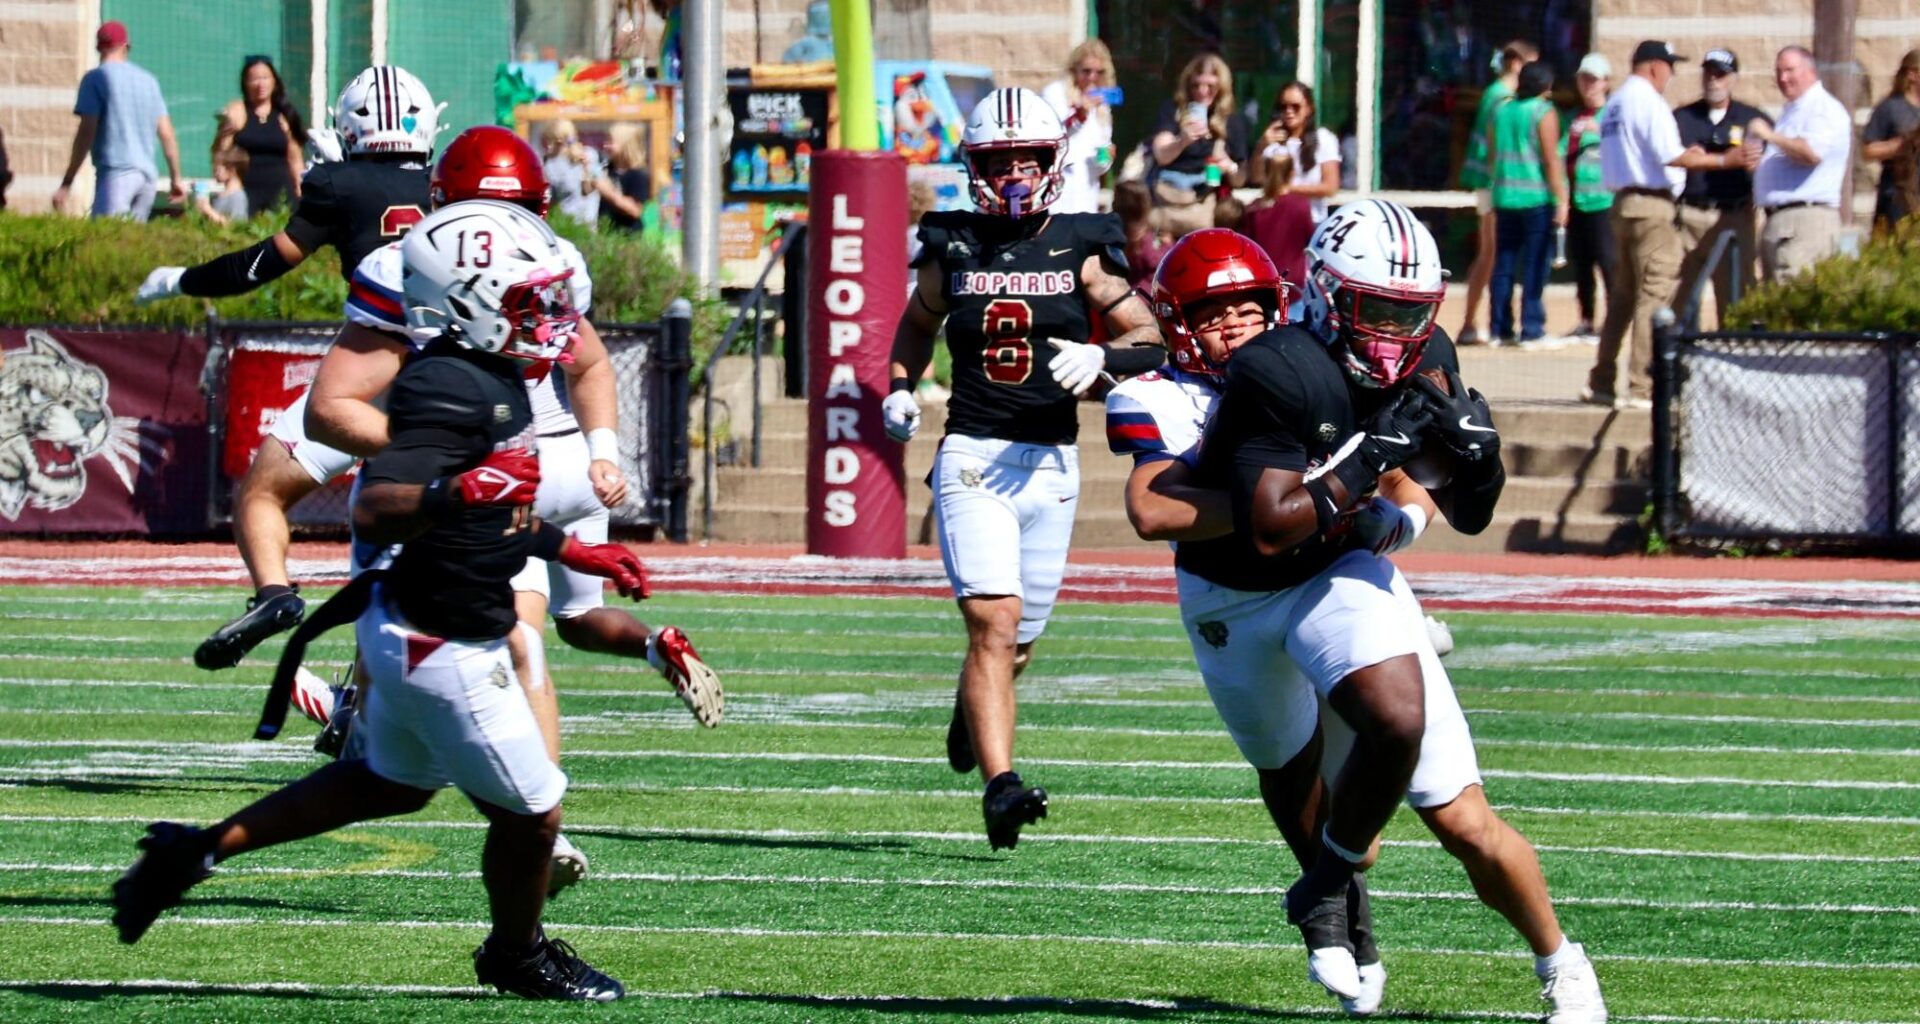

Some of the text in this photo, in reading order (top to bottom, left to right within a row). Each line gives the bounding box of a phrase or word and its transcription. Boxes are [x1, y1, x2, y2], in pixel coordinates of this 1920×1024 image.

[748, 93, 802, 113] PICK
[456, 230, 493, 269] 13
[1315, 214, 1358, 254] 24
[952, 270, 1075, 296] LEOPARDS
[823, 194, 865, 528] LEOPARDS
[982, 299, 1033, 385] 8
